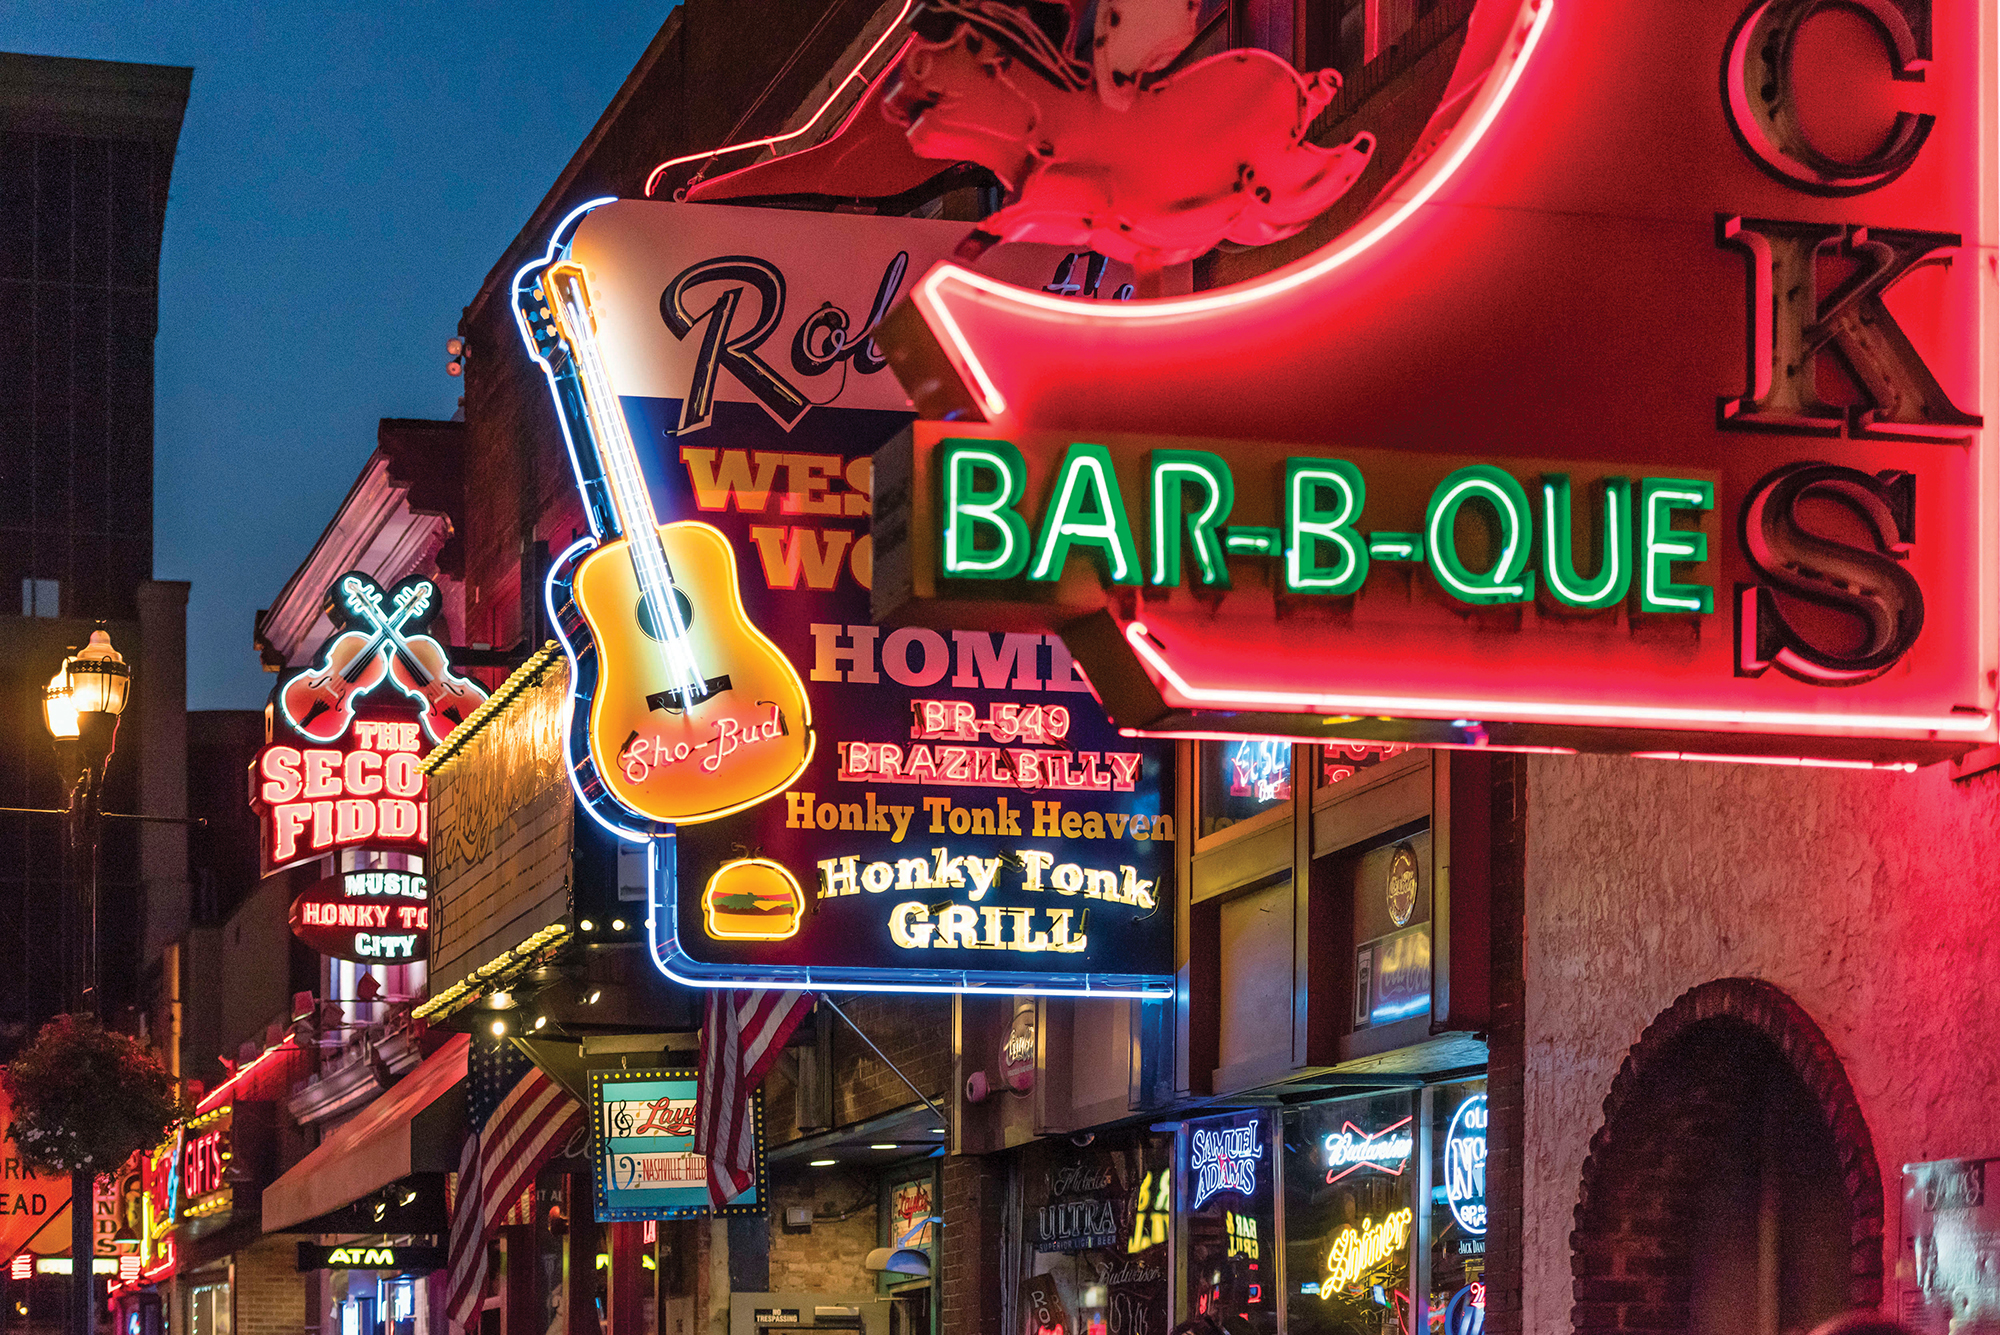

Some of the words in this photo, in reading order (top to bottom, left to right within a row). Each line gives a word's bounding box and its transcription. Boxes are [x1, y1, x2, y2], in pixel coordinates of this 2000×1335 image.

[942, 438, 1715, 614] BAR-B-QUE
[354, 720, 420, 752] THE
[622, 705, 783, 784] Sho-Bud
[911, 699, 1071, 745] BR-549
[261, 746, 428, 804] SECO
[838, 742, 1143, 791] BRAZILBILLY
[786, 792, 915, 843] Honky
[923, 797, 1022, 837] Tonk
[1032, 801, 1175, 841] Heaven
[344, 872, 428, 900] MUSIC
[817, 847, 1003, 901] Honky
[1015, 850, 1156, 909] Tonk
[302, 903, 390, 928] HONKY
[888, 901, 1087, 953] GRILL
[354, 932, 418, 957] CITY
[185, 1130, 221, 1199] GIFTS
[1191, 1119, 1263, 1170] SAMUEL
[642, 1158, 682, 1182] NASHVILLE
[1194, 1159, 1255, 1210] ADAMS
[1039, 1198, 1117, 1241] ULTRA
[1098, 1235, 1117, 1245] BEER
[328, 1248, 395, 1265] ATM
[1320, 1207, 1412, 1300] Shiner
[756, 1314, 798, 1323] TRESPASSING
[772, 1308, 782, 1316] NO
